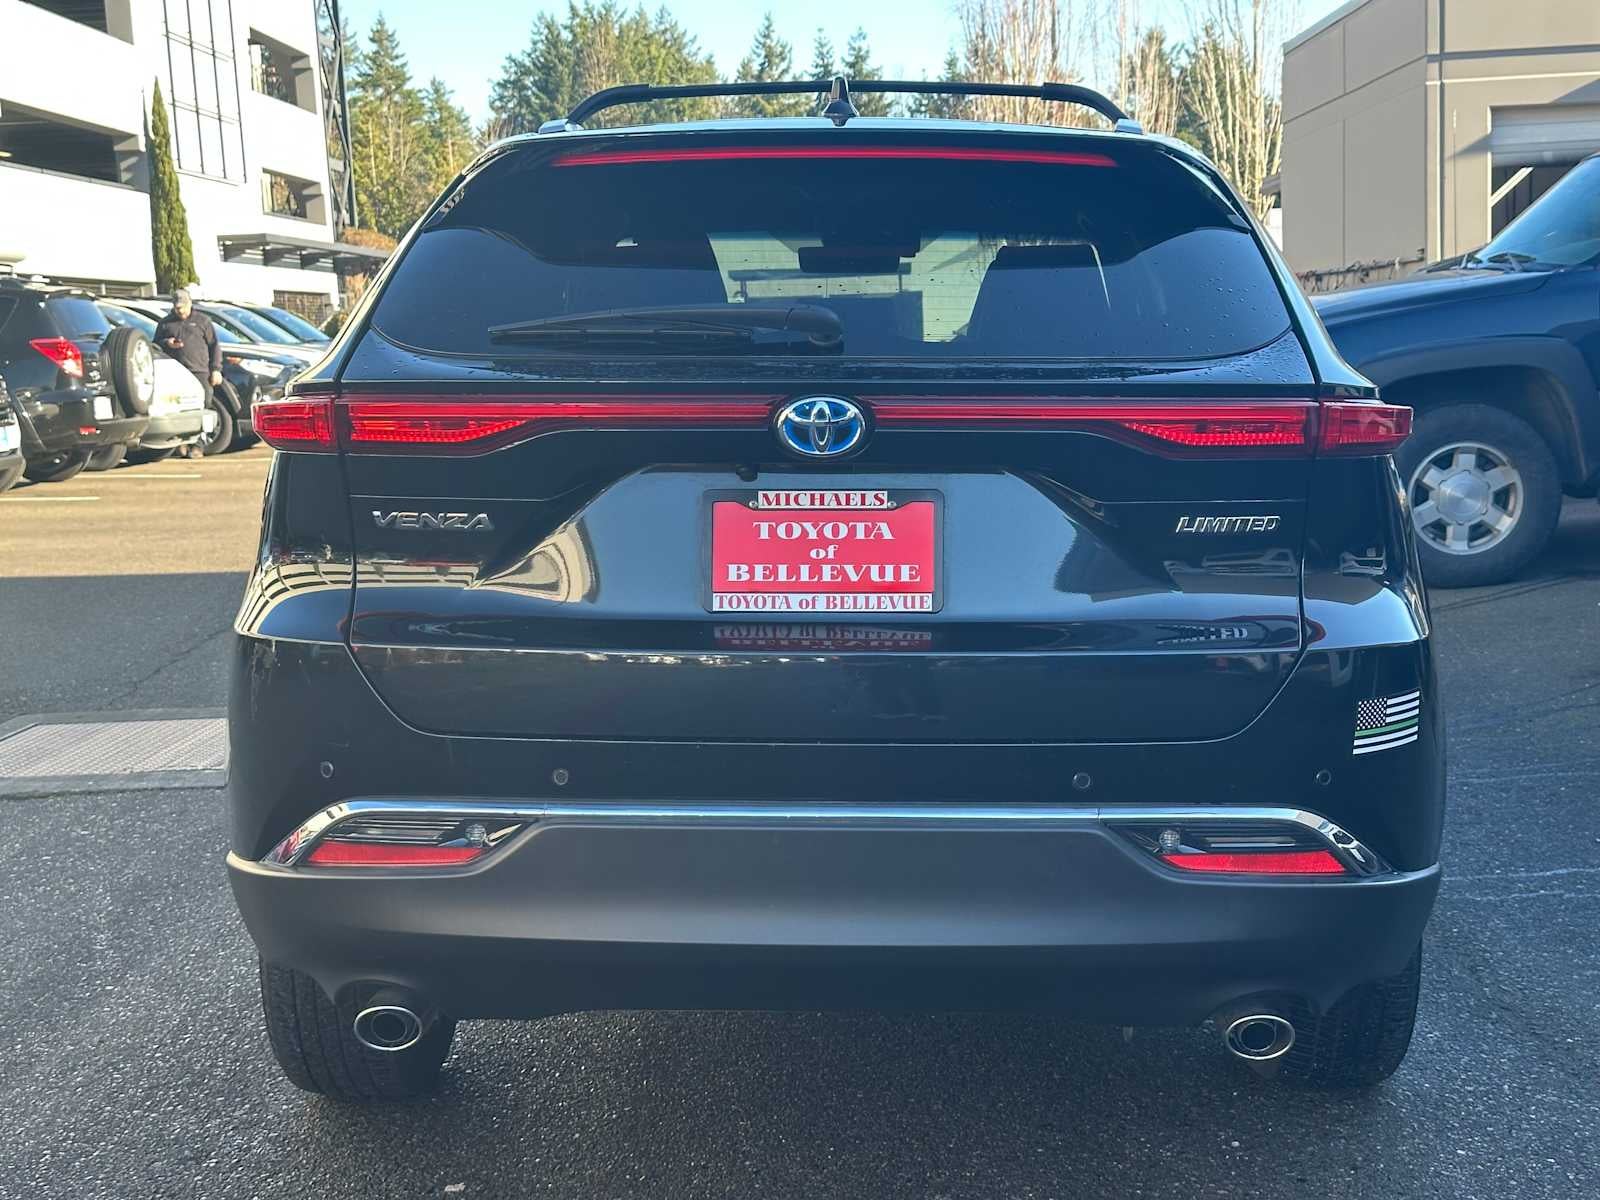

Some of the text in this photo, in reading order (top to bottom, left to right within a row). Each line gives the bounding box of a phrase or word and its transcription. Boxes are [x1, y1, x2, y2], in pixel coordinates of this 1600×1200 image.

[760, 492, 886, 507] MICHAELS
[372, 510, 495, 530] VENZA
[1175, 515, 1281, 533] LIMITED
[752, 521, 896, 540] TOYOTA
[809, 544, 839, 560] of
[726, 563, 921, 582] BELLEVUE
[714, 594, 930, 610] TOYOTA of BELLEVUE
